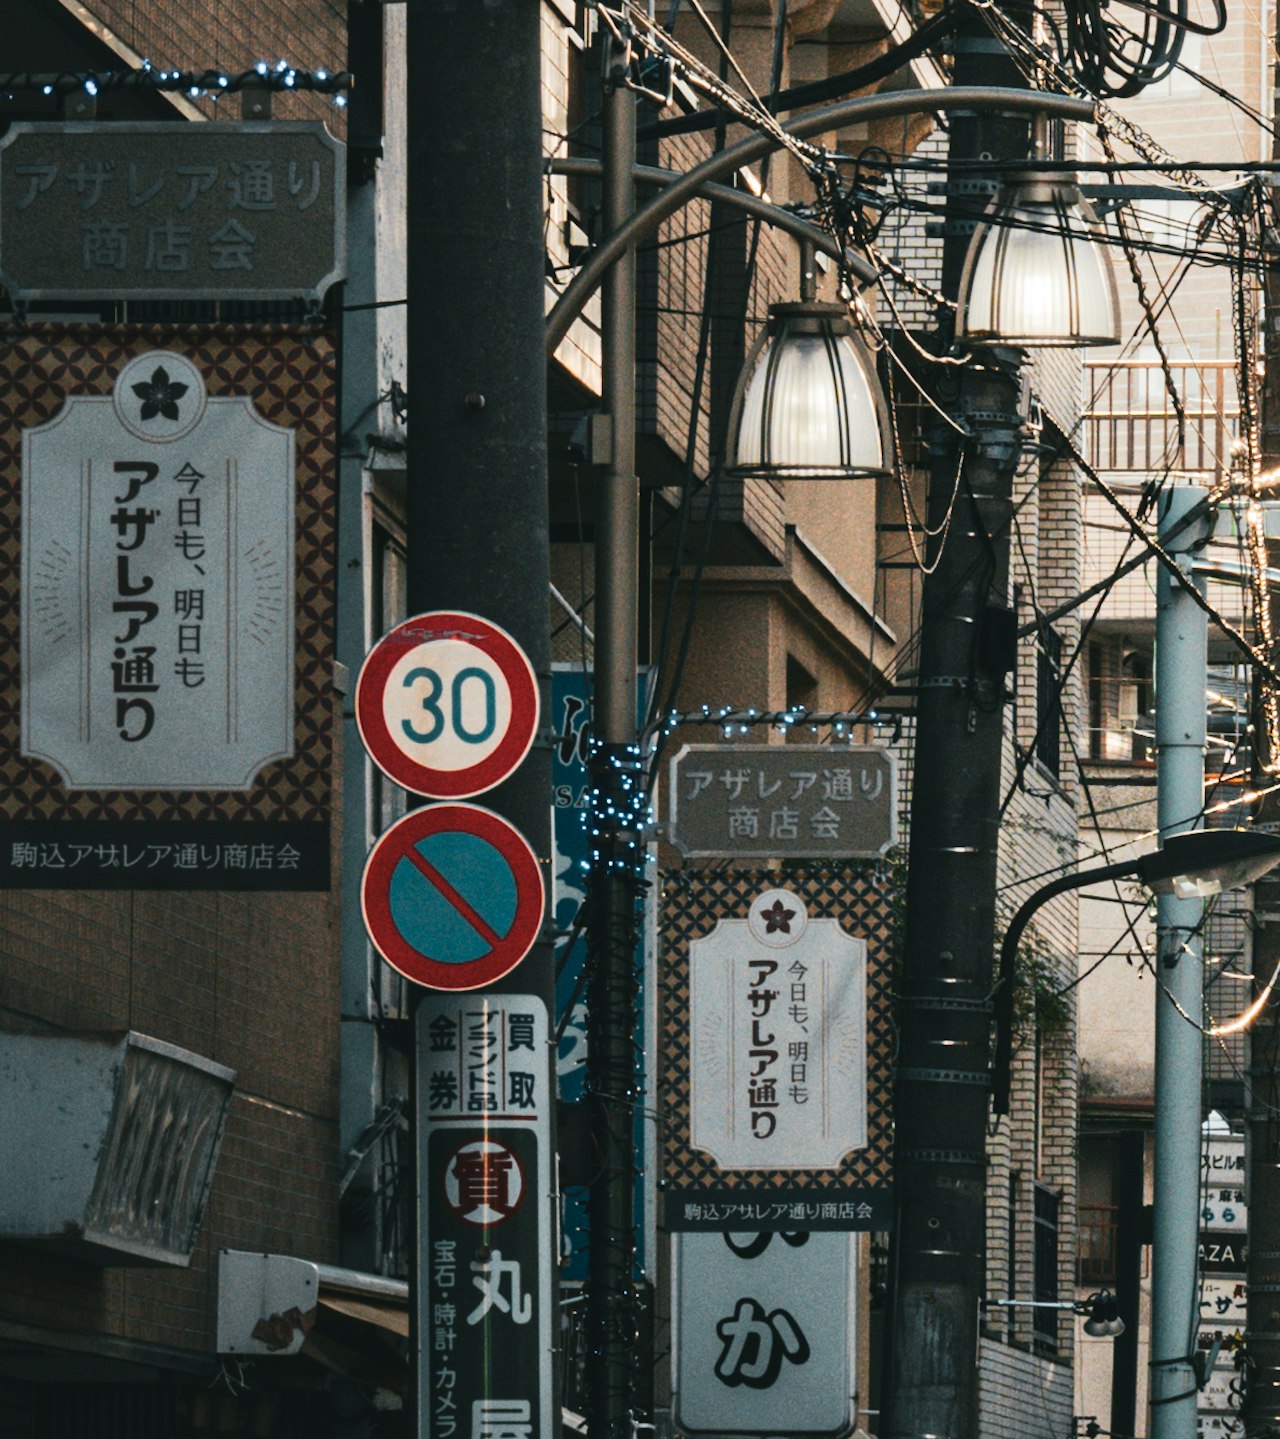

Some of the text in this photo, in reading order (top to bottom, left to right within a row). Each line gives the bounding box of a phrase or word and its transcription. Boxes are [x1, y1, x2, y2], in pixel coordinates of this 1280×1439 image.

[14, 160, 324, 212] アザレア通り
[81, 219, 256, 272] 商店会
[110, 459, 161, 744] アザレア通り
[173, 462, 206, 688] 今日も、明日も
[400, 666, 497, 745] 30
[685, 768, 884, 804] アザレア通り
[11, 842, 302, 872] 駒込アザレア通り商店会
[728, 805, 841, 840] 商店会
[428, 1013, 458, 1111] 金券
[507, 1013, 536, 1109] 買取
[747, 959, 780, 1140] アザレア通り
[788, 960, 810, 1104] 今日も、明日も
[451, 1150, 514, 1209] 質
[684, 1202, 873, 1221] 駒込アザレア通り商店会
